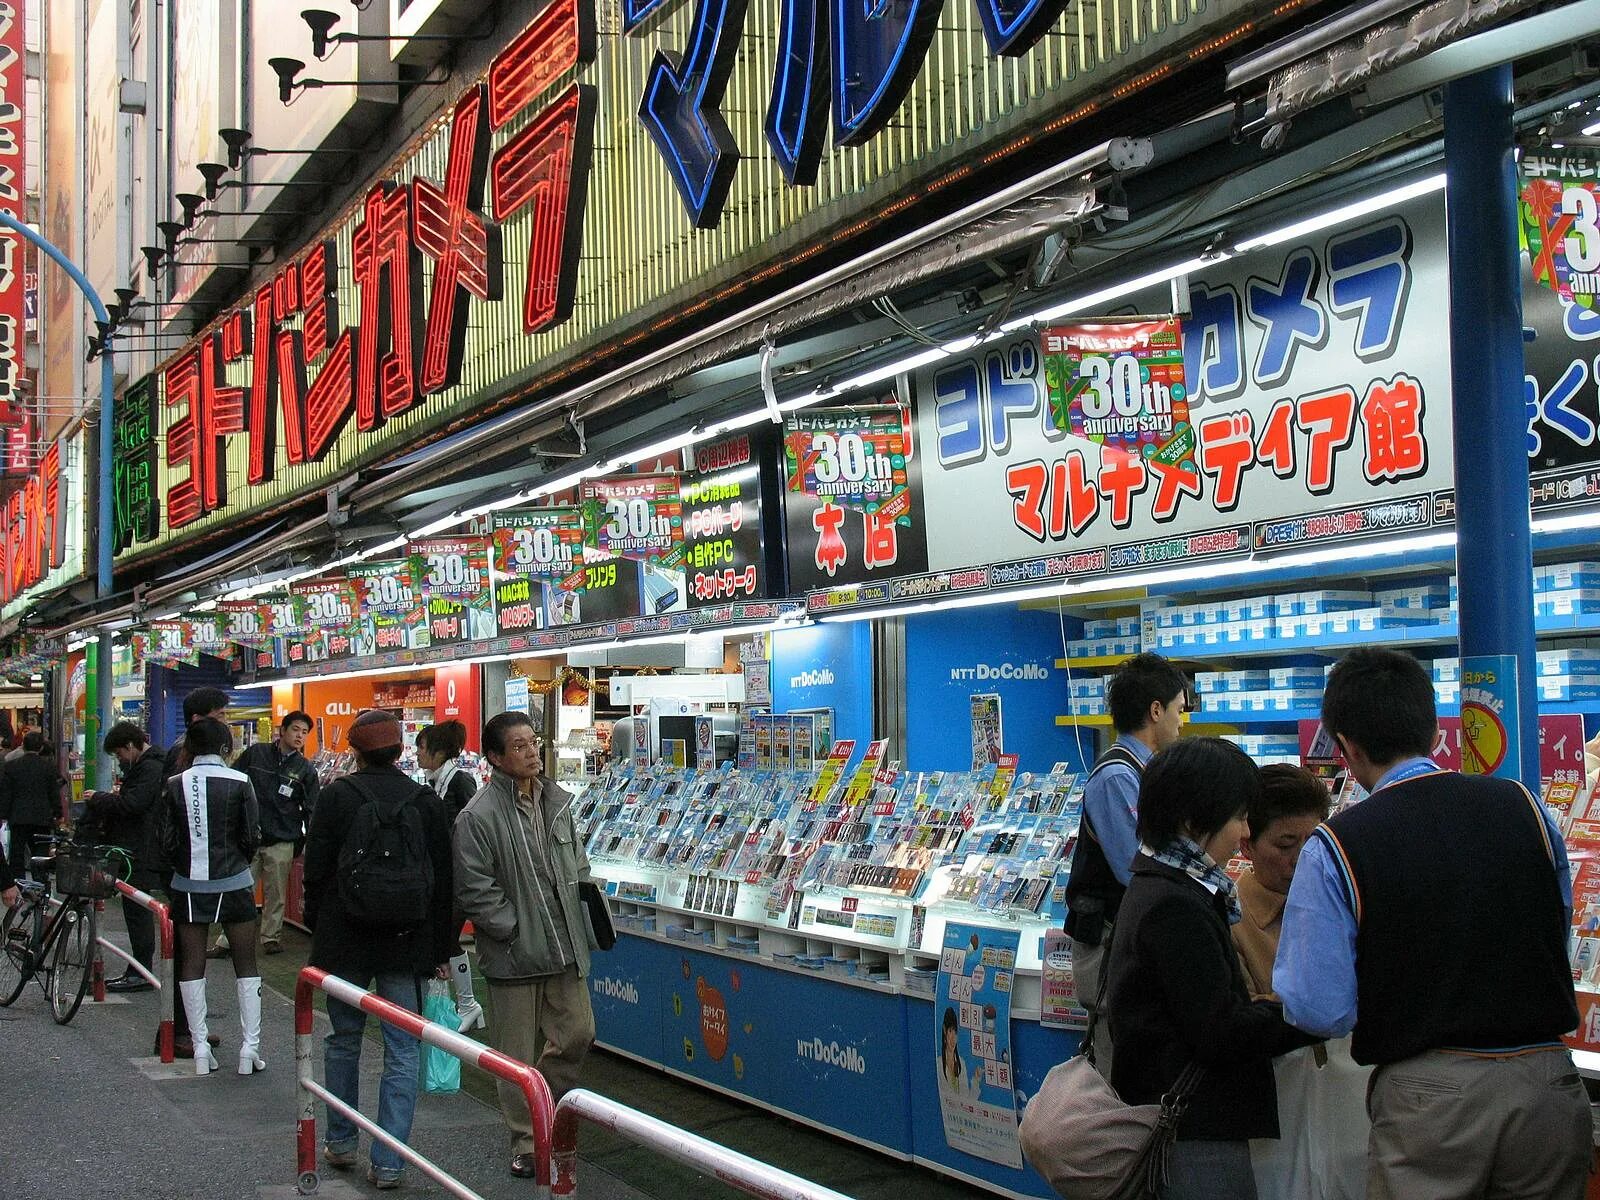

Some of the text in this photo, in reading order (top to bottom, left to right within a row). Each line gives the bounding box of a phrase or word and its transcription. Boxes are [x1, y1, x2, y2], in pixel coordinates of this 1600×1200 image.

[166, 0, 582, 527] ヨドバシカメラ
[1079, 355, 1172, 418] 30th
[787, 416, 871, 431] ヨドバシカメラ
[1083, 414, 1173, 435] anniversary
[812, 434, 892, 483] 30th
[584, 484, 655, 498] ヨドバシカメラ
[815, 478, 893, 496] anniversary
[495, 516, 559, 527] ヨドバシカメラ
[605, 499, 671, 540] 30th
[513, 529, 572, 563] 30th
[608, 535, 672, 550] anniversary
[693, 539, 734, 567] 自作PC
[427, 554, 480, 586] 30th
[515, 560, 573, 573] anniversary
[364, 576, 413, 605] 30th
[429, 582, 481, 594] anniversary
[694, 565, 757, 600] ネットワーク
[307, 592, 350, 620] 30th
[367, 600, 414, 613] anniversary
[802, 671, 834, 687] DoCoMo
[951, 664, 1049, 680] NTT DoCoMo
[325, 703, 350, 716] au
[192, 775, 202, 838] MOTOROLA
[944, 951, 961, 968] どん
[593, 977, 639, 1005] NTT DoCoMo
[951, 979, 970, 997] どん
[702, 1003, 725, 1021] おサイフ
[960, 1007, 980, 1025] 割引
[702, 1019, 726, 1036] ケータイ
[973, 1034, 994, 1052] 最大
[797, 1037, 866, 1074] NTT DoCoMo
[986, 1065, 1009, 1084] 半額
